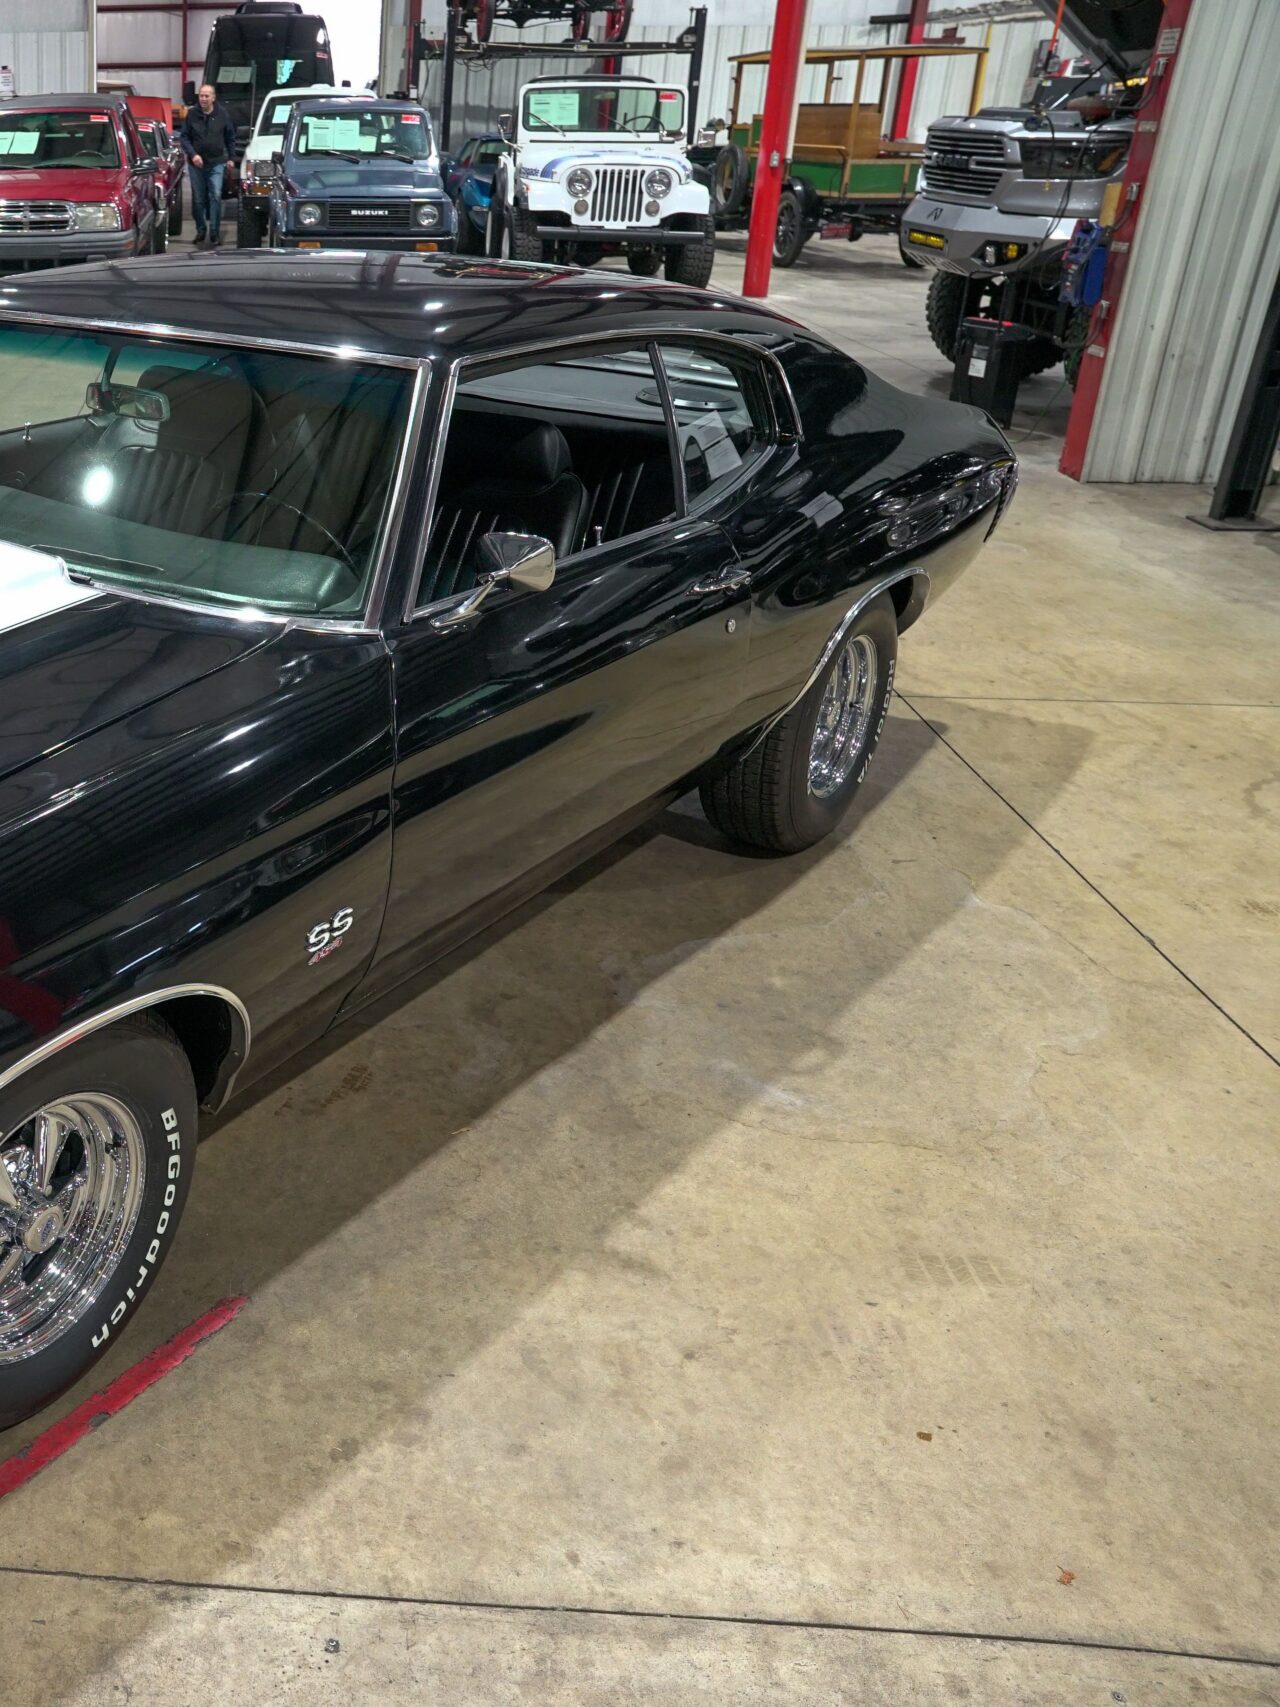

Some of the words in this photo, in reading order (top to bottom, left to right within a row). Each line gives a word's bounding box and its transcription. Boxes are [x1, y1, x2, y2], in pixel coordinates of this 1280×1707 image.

[874, 659, 895, 743] Radial
[857, 752, 873, 783] T/A
[308, 906, 354, 953] SS
[91, 1107, 181, 1348] BFGoodrich
